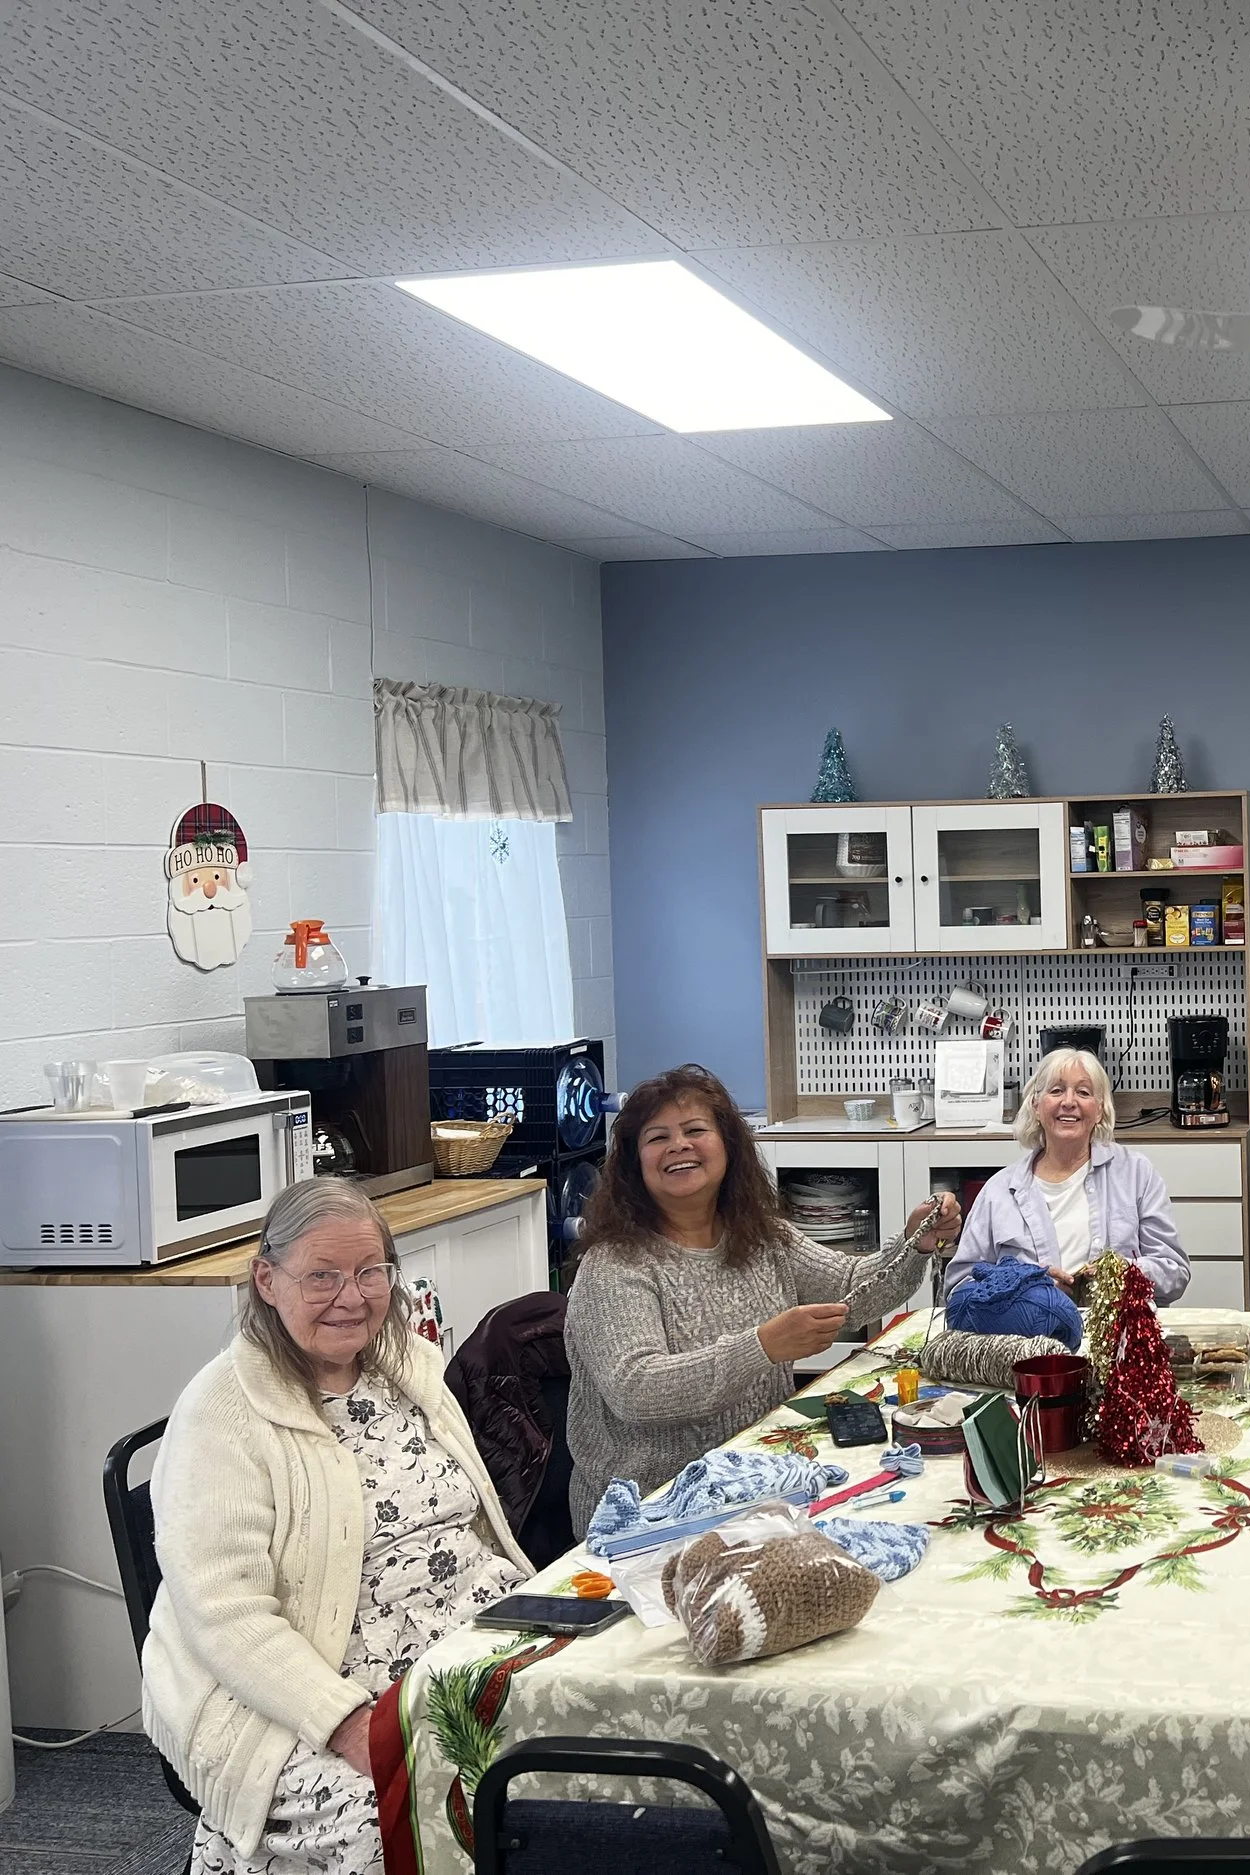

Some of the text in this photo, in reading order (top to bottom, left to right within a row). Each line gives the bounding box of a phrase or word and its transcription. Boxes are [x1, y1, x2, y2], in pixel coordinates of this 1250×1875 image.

[174, 846, 234, 871] HO HO HO
